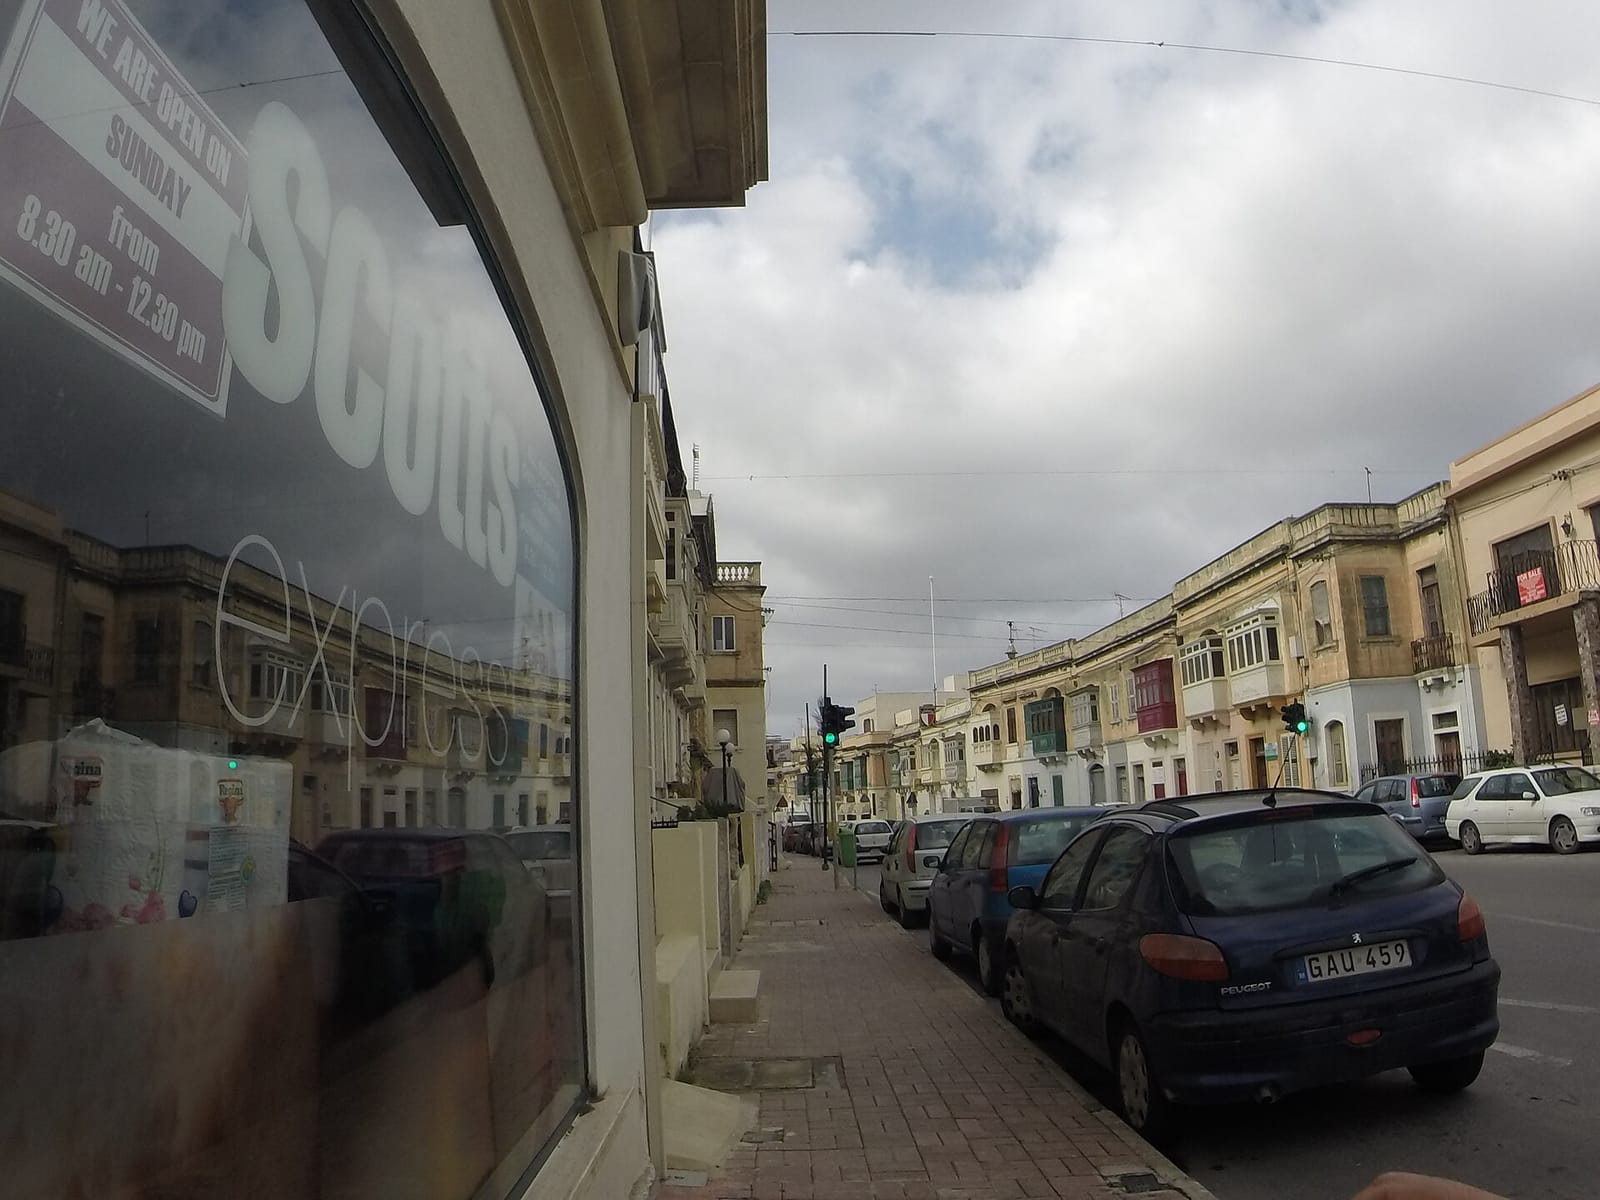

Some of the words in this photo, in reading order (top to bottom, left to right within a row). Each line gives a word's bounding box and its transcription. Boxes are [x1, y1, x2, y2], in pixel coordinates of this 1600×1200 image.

[76, 0, 118, 59] WE
[113, 36, 158, 106] ARE
[156, 81, 206, 158] OPEN
[206, 134, 231, 187] ON
[106, 114, 191, 219] SUNDAY
[17, 194, 76, 267] 8.30
[74, 244, 113, 296] am
[115, 283, 124, 292] -
[127, 275, 179, 342] 12.30
[176, 319, 206, 364] pm
[108, 205, 160, 276] from
[216, 534, 509, 791] express
[1220, 981, 1273, 996] PEUGEOT
[1308, 950, 1355, 979] GAU
[1366, 943, 1405, 968] 459
